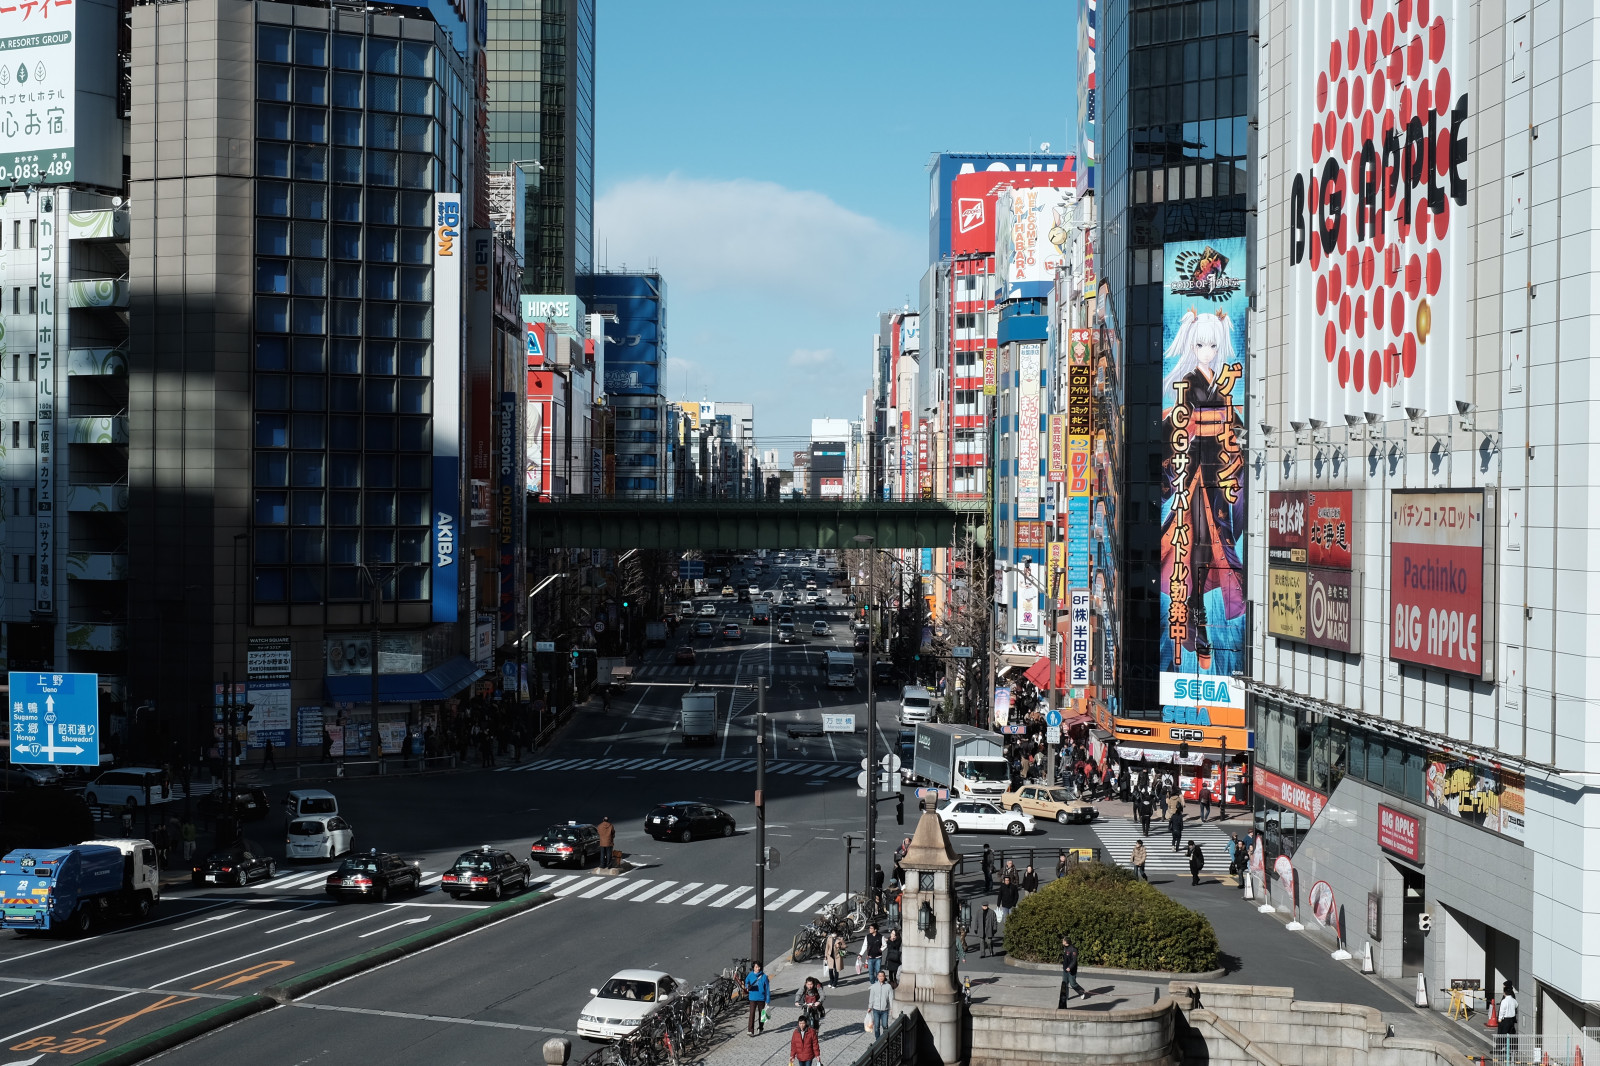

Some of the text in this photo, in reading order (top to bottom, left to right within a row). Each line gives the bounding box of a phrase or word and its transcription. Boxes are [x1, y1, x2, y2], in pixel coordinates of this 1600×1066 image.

[7, 37, 40, 49] RESORTS
[42, 32, 70, 44] GROUP
[14, 154, 39, 164] おやすみ
[1290, 92, 1469, 267] BIG APPLE
[438, 202, 460, 256] EDION
[1014, 197, 1026, 279] AKIHABARA
[1027, 192, 1038, 265] WELCOME TO
[1171, 273, 1240, 294] CODE OF JOKER
[39, 219, 53, 395] カプセルホテル
[528, 301, 569, 317] HIROSE
[1071, 366, 1089, 375] ゲーム
[1073, 376, 1087, 385] CD
[1070, 396, 1089, 404] アニメ
[1071, 386, 1089, 395] アイドル
[1071, 426, 1089, 434] フィギュア
[1072, 416, 1088, 424] ホビー
[501, 401, 515, 476] Panasonic
[1019, 396, 1030, 470] まんが喫茶
[1030, 396, 1039, 470] インターネット
[1216, 362, 1242, 504] ゲーセンで
[906, 449, 914, 475] AKKY
[1070, 452, 1088, 493] DVD
[40, 467, 50, 500] カフェ
[502, 485, 513, 544] ONODEN
[1169, 381, 1191, 667] TCGサイバーバトル勃発中!
[437, 512, 453, 568] AKIBA
[1018, 526, 1042, 537] 麻雀
[1310, 520, 1348, 552] 北海道
[1404, 556, 1467, 595] Pachinko
[1073, 595, 1089, 606] 8F
[1327, 600, 1349, 623] NIJYU
[1327, 620, 1349, 643] MARU
[1395, 603, 1477, 663] BIG APPLE
[37, 674, 64, 687] 上野
[1173, 678, 1232, 703] SEGA
[13, 701, 39, 714] 巣鴨
[13, 714, 39, 722] Sugamo
[1162, 705, 1212, 727] SEGA
[13, 722, 39, 734] 本郷
[16, 734, 36, 742] Hongo
[58, 723, 96, 736] 昭和通り
[61, 735, 93, 743] Showadori
[31, 744, 40, 754] 17
[1281, 781, 1293, 804] BIG
[1292, 787, 1311, 812] APPLE
[1381, 810, 1393, 829] BIG
[1394, 815, 1415, 839] APPLE
